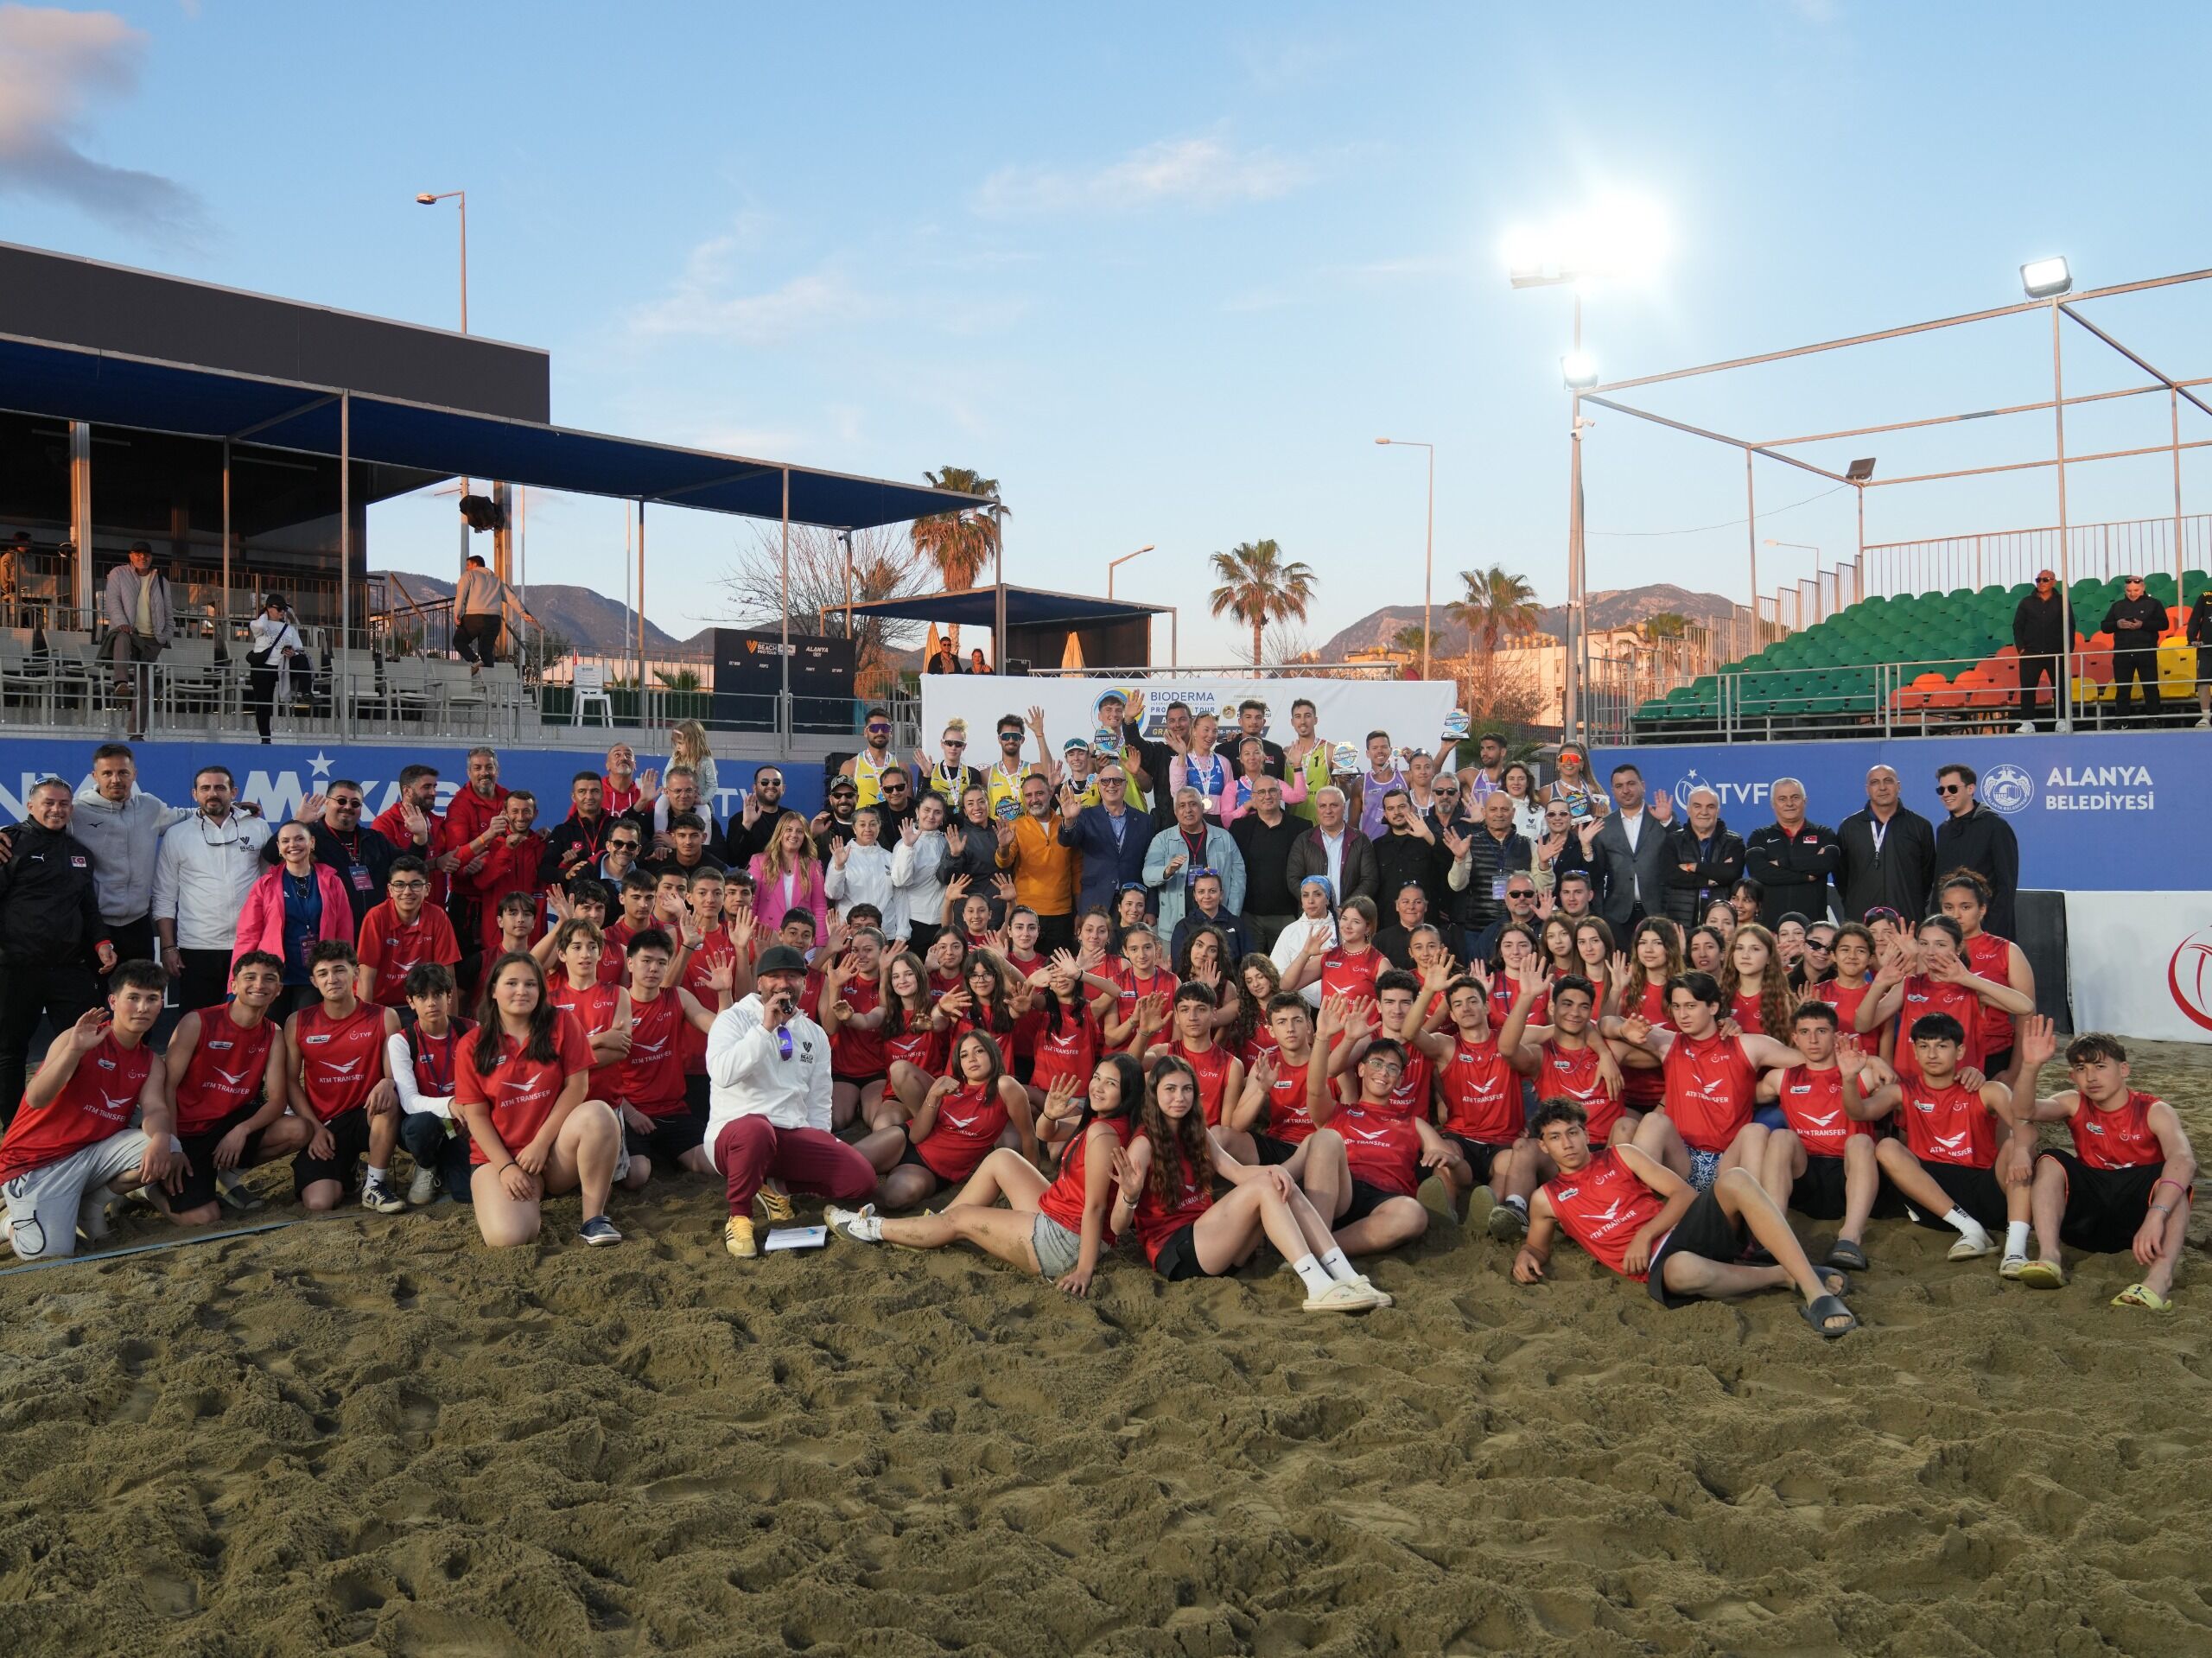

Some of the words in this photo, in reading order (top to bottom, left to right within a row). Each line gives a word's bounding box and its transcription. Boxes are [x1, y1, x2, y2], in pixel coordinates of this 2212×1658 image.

[1151, 691, 1215, 702] BIODERMA
[1313, 755, 1320, 768] 1
[961, 776, 967, 785] 2
[2046, 765, 2153, 786] ALANYA
[1716, 783, 1769, 804] TVF
[2045, 791, 2154, 810] BELEDİYESİ
[217, 1083, 250, 1095] TRANSFER
[500, 1099, 515, 1109] ATM
[515, 1089, 550, 1103] TRANSFER
[1472, 1093, 1503, 1102] TRANSFER
[84, 1104, 98, 1115] ATM
[99, 1109, 127, 1122] TRANSFE
[1604, 1169, 1617, 1179] TVF
